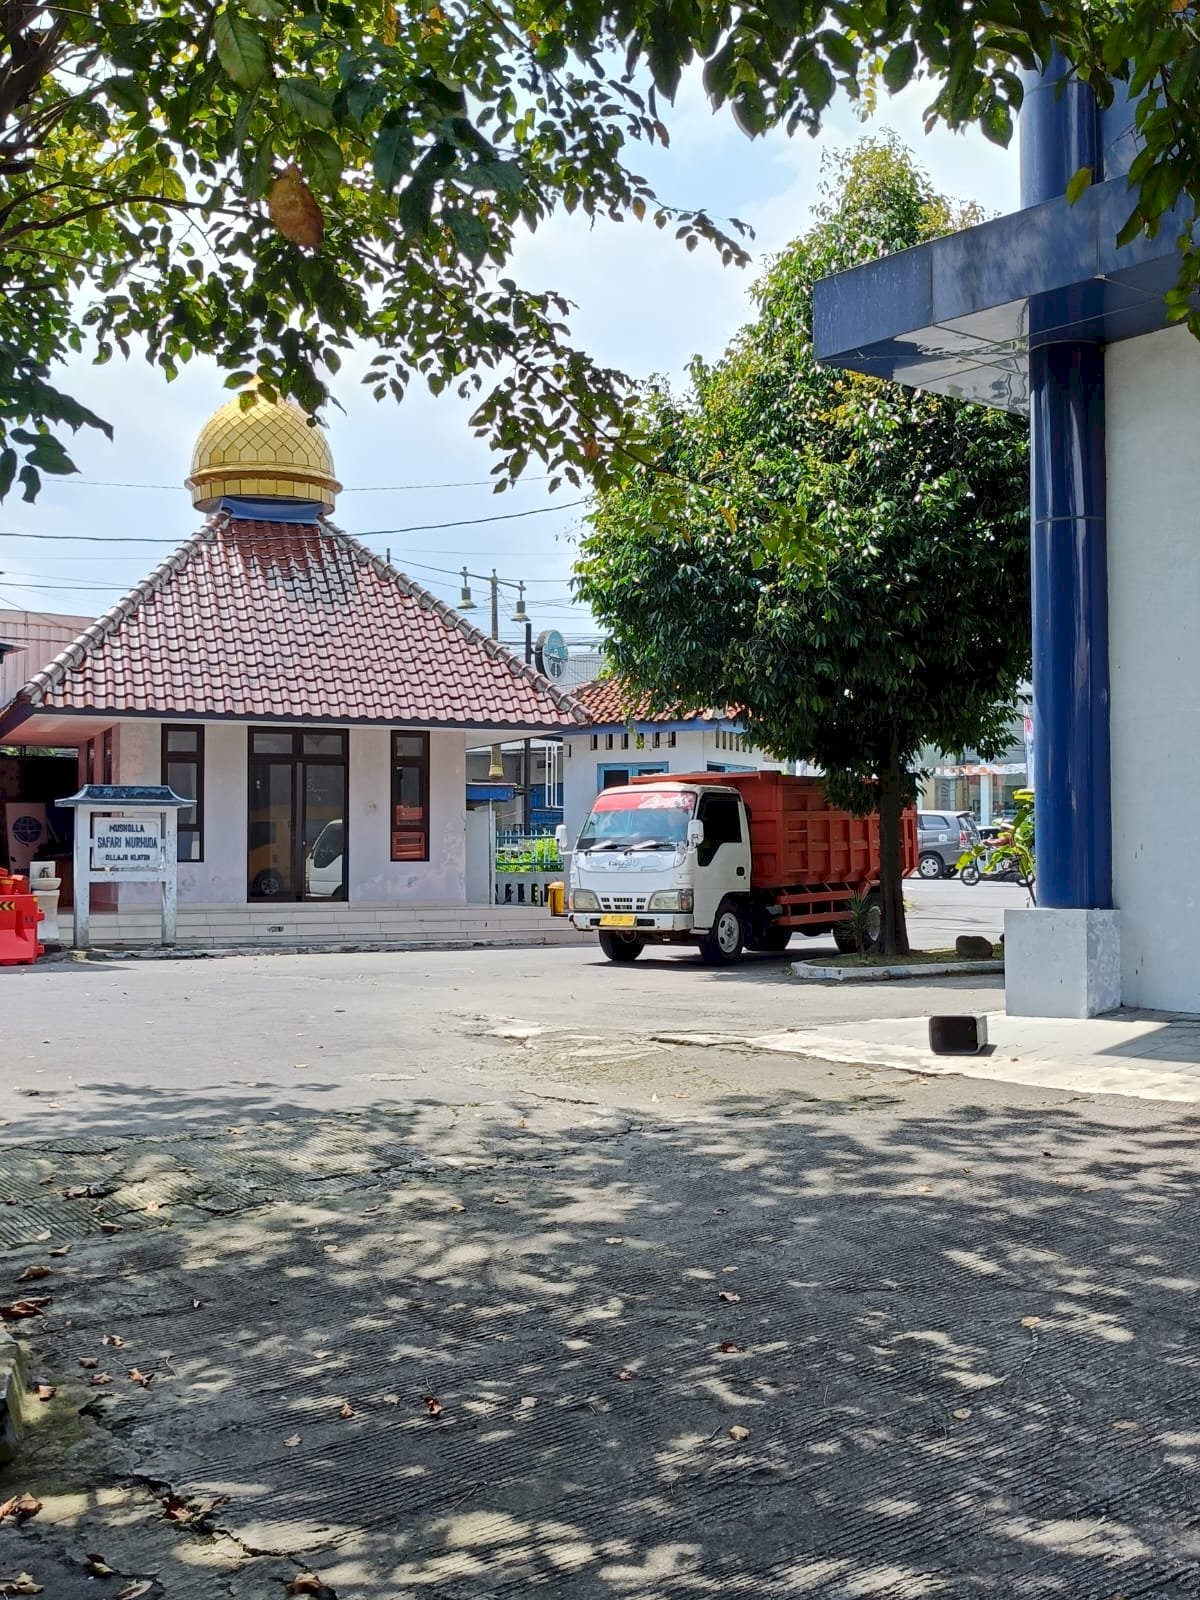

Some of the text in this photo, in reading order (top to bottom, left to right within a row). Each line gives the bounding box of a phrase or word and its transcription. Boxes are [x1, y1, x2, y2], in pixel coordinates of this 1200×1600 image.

[109, 824, 145, 832] MUSHOLLA
[97, 836, 158, 848] SAFARI NURHUDA
